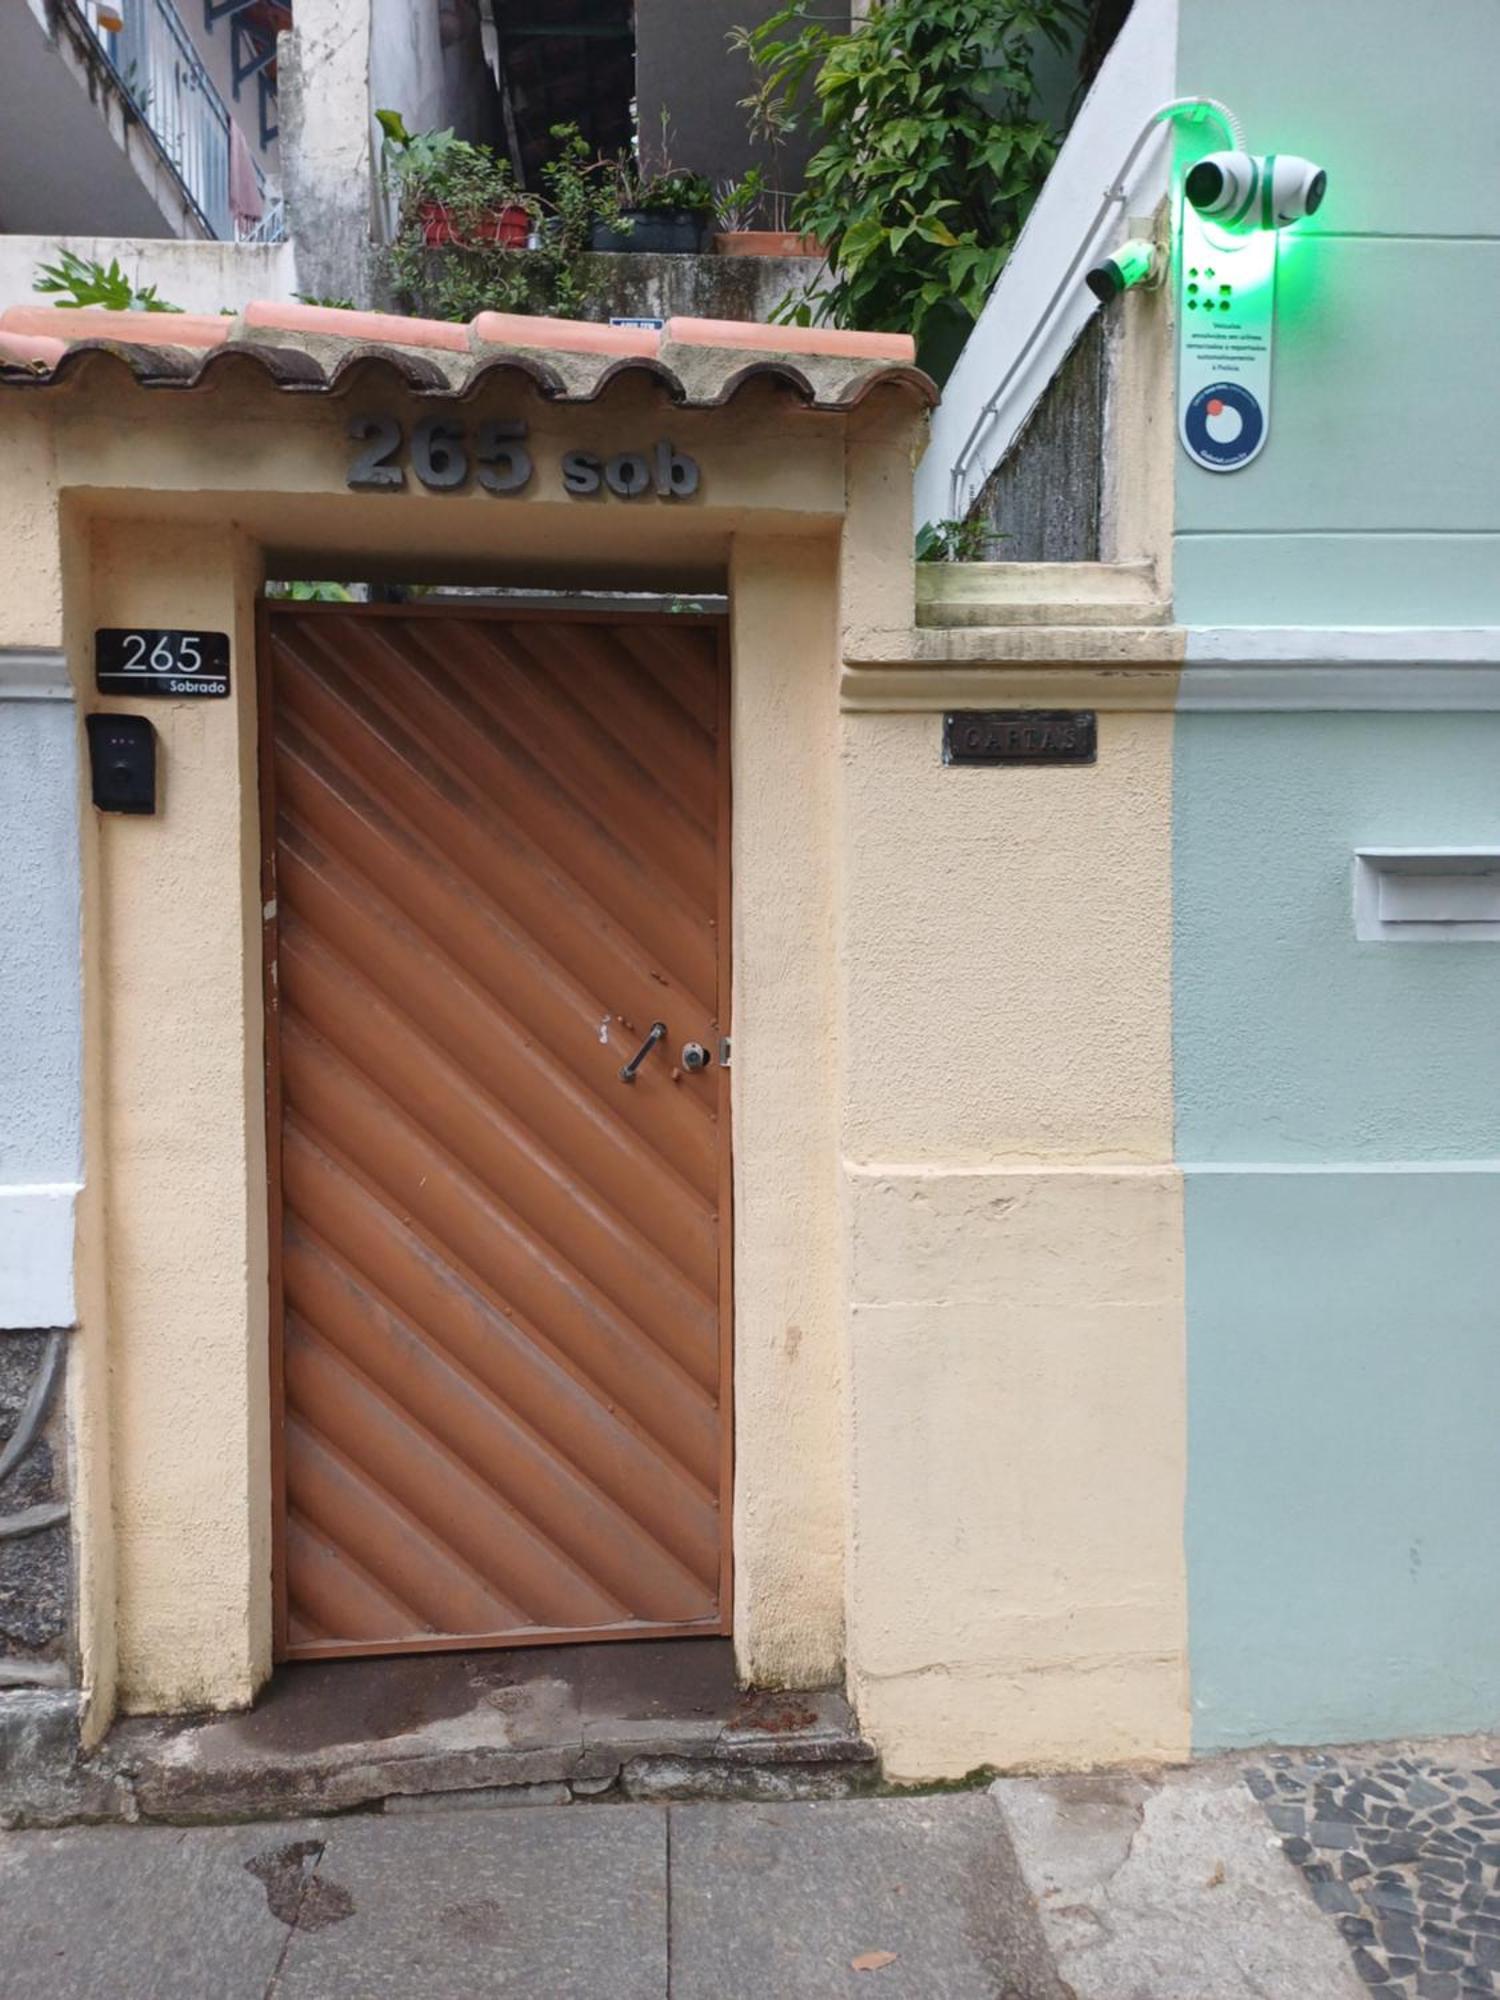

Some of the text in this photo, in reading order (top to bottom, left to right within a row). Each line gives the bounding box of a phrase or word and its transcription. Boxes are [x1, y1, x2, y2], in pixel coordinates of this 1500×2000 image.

[346, 415, 699, 499] 265 sob
[122, 635, 202, 672] 265
[169, 680, 226, 694] Sobrado
[965, 726, 1077, 749] CARTAS
